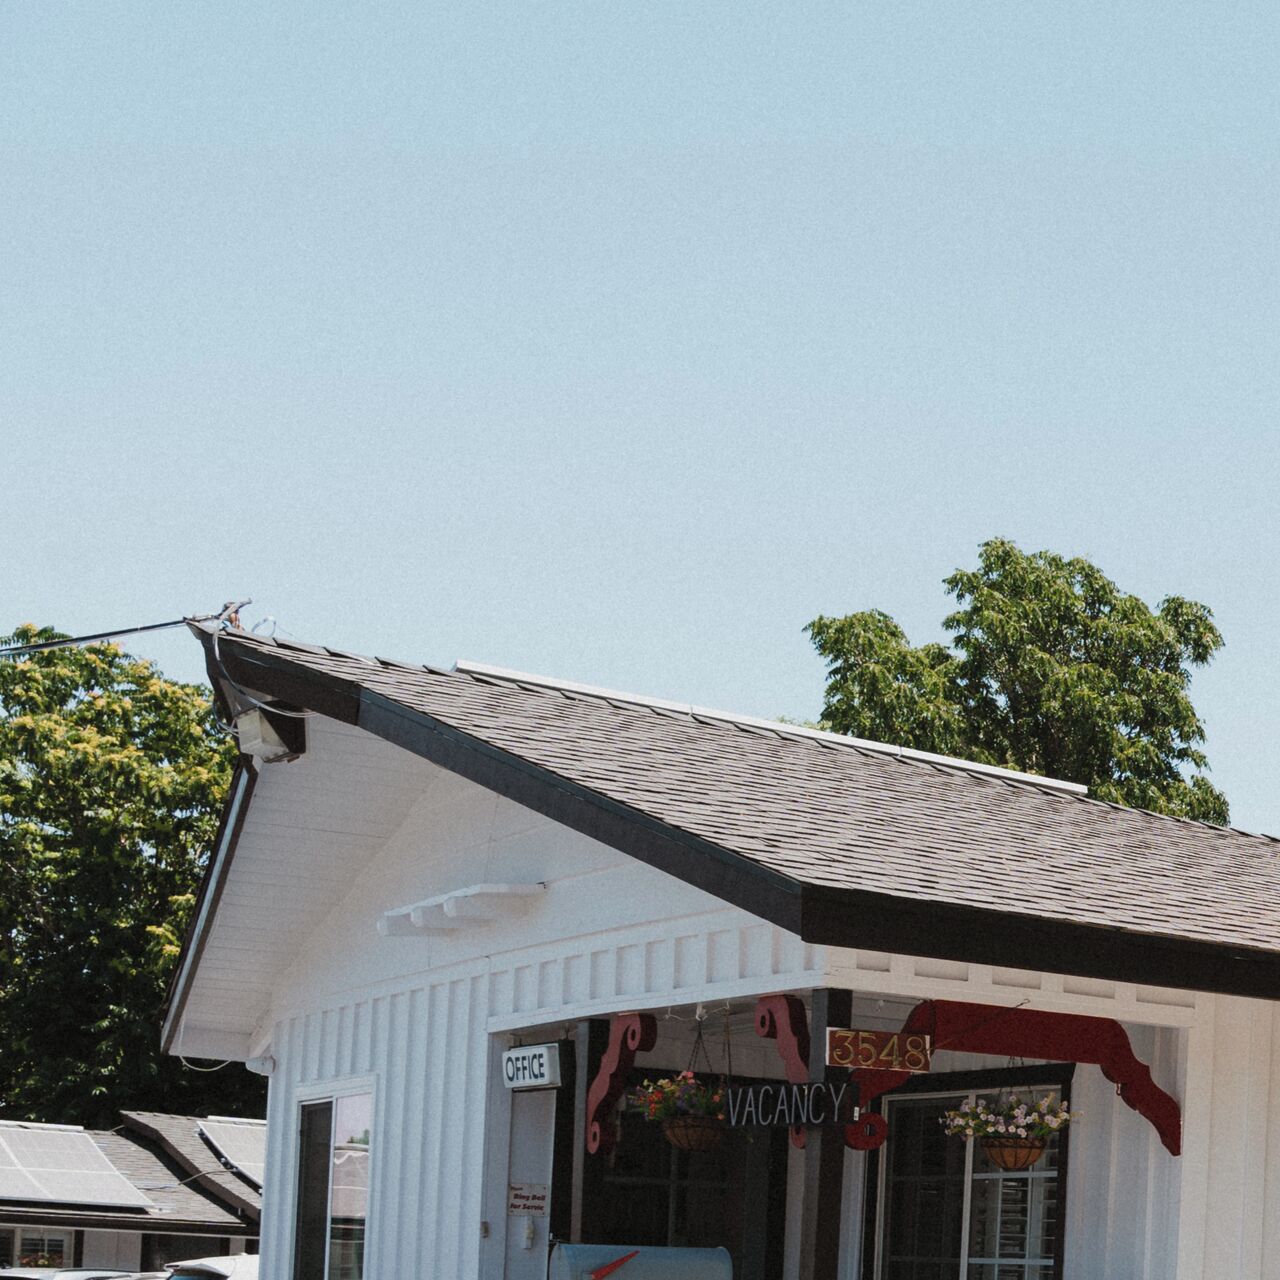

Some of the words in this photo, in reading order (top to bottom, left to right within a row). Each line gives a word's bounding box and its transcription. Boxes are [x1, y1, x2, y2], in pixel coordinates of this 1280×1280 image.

[505, 1053, 545, 1082] OFFICE
[833, 1031, 925, 1069] 3548
[728, 1083, 847, 1126] VACANCY
